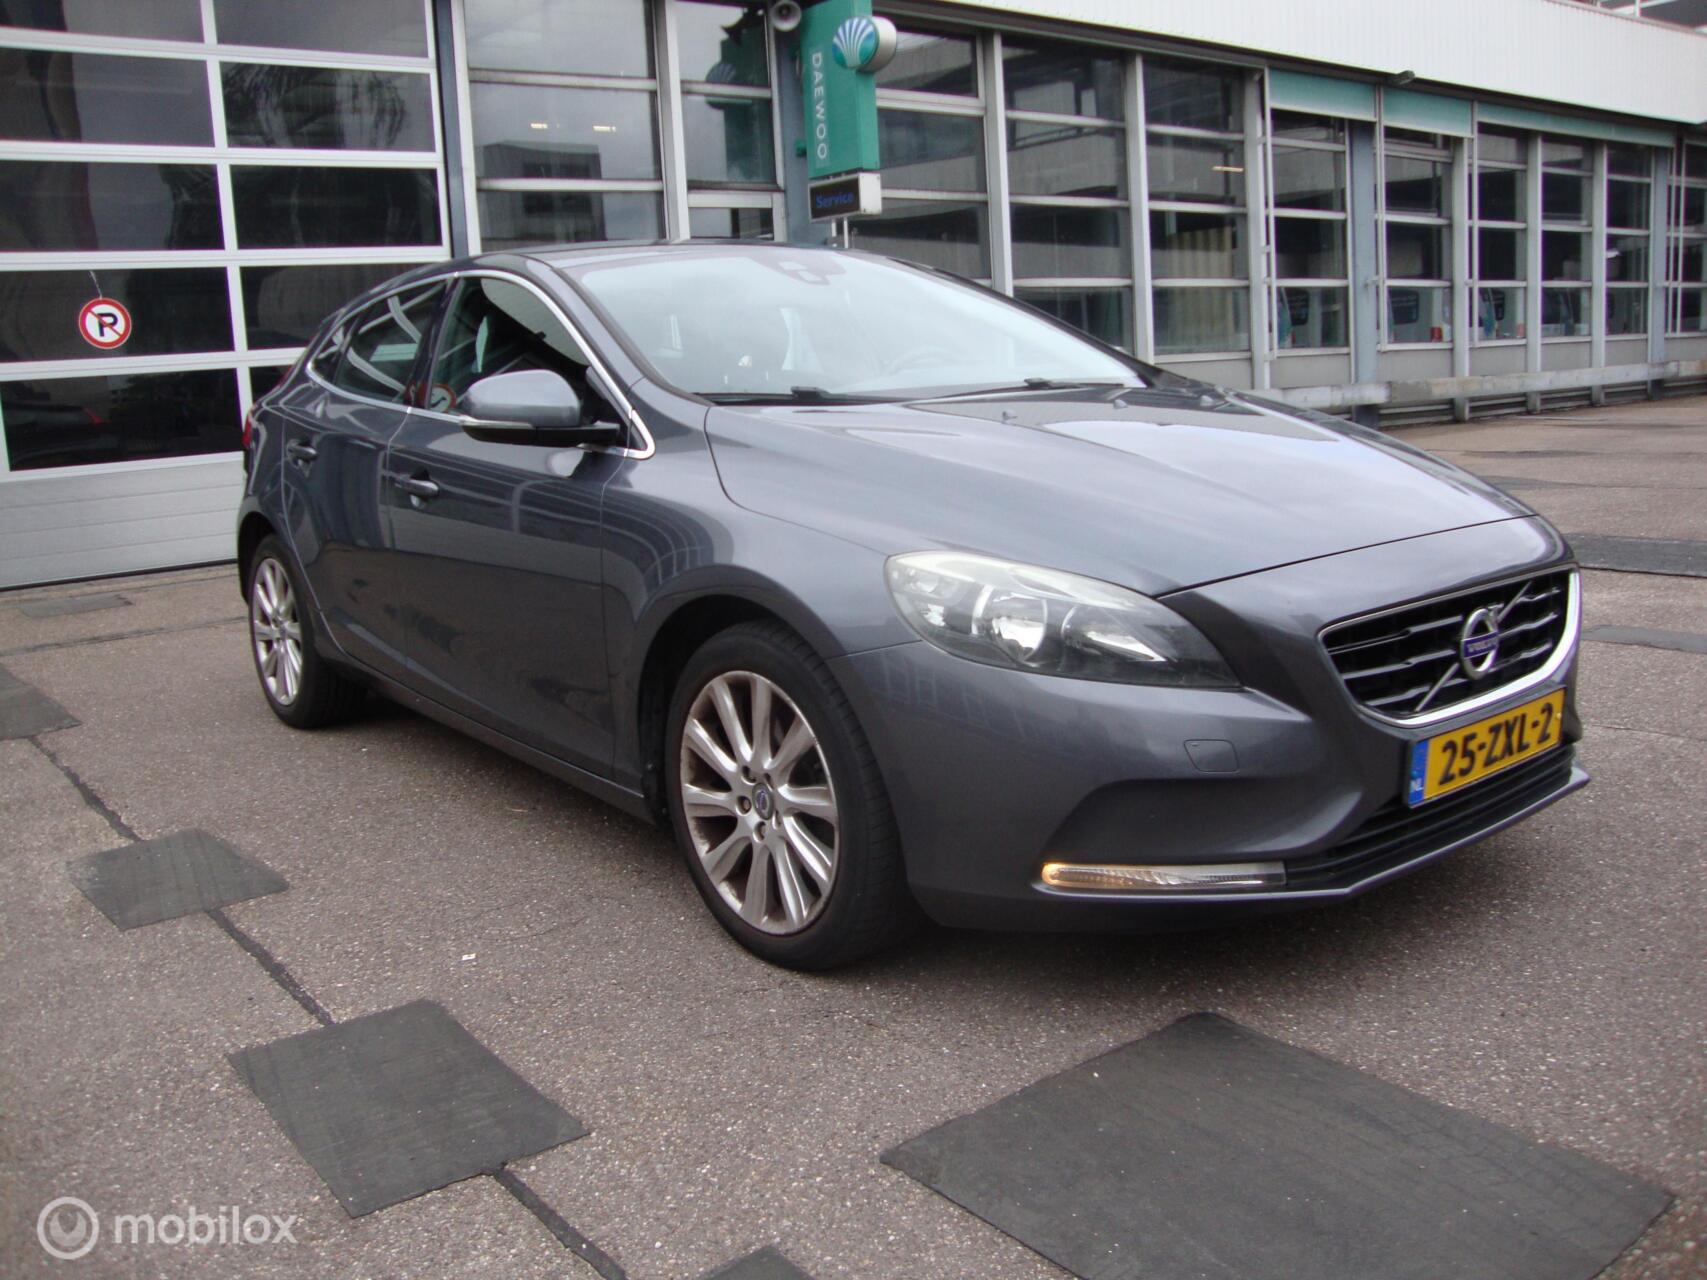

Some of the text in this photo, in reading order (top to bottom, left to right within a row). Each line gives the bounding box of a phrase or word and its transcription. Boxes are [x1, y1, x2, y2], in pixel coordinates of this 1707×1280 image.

[812, 52, 828, 160] DAEWOO
[816, 192, 855, 209] Service
[1438, 702, 1555, 786] 25-ZXL-2
